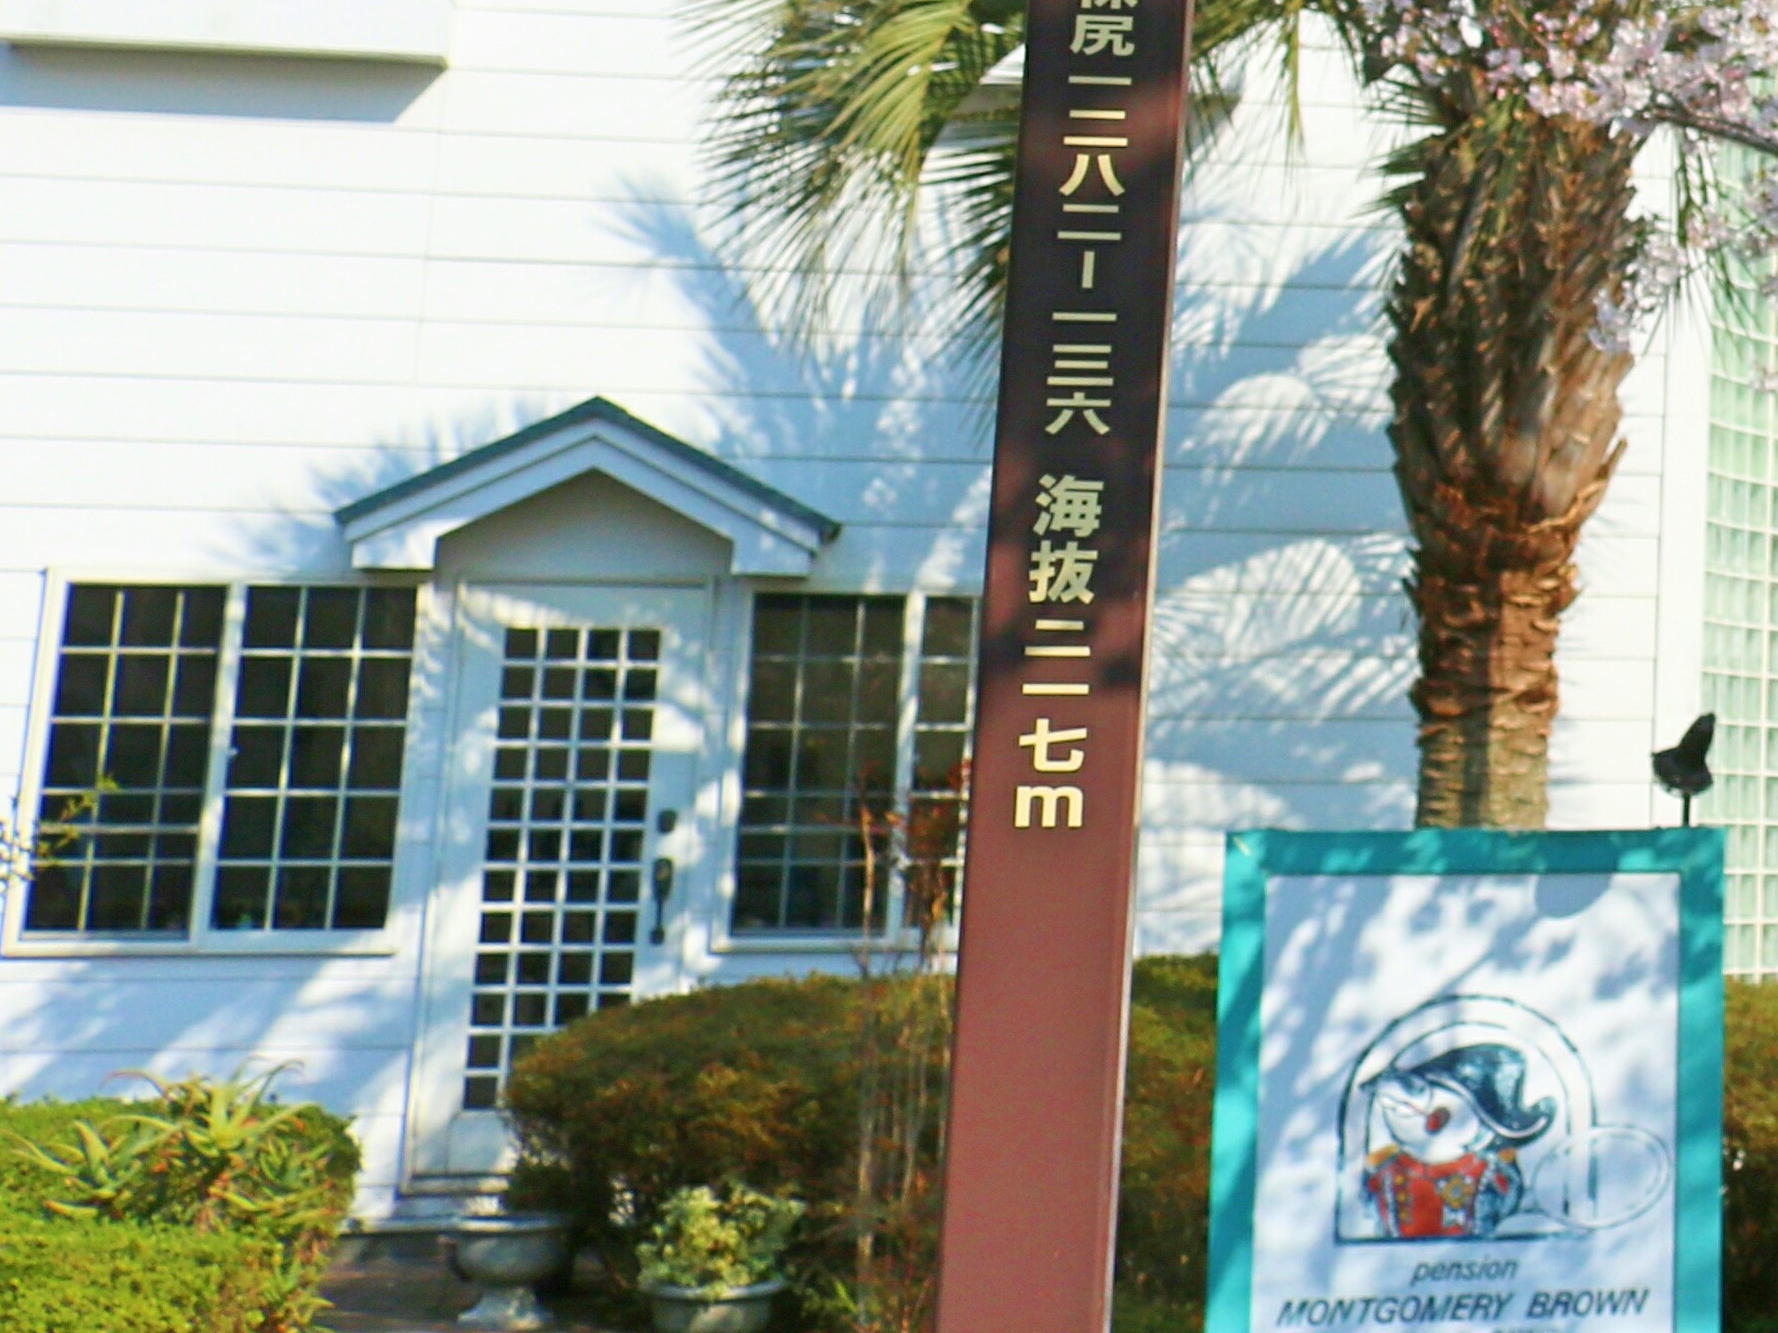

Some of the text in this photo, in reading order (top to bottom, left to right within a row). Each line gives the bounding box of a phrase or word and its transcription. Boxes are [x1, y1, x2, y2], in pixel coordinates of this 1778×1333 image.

[1410, 1254, 1519, 1287] pension
[1276, 1288, 1651, 1328] MONTGOMERY BROWN
